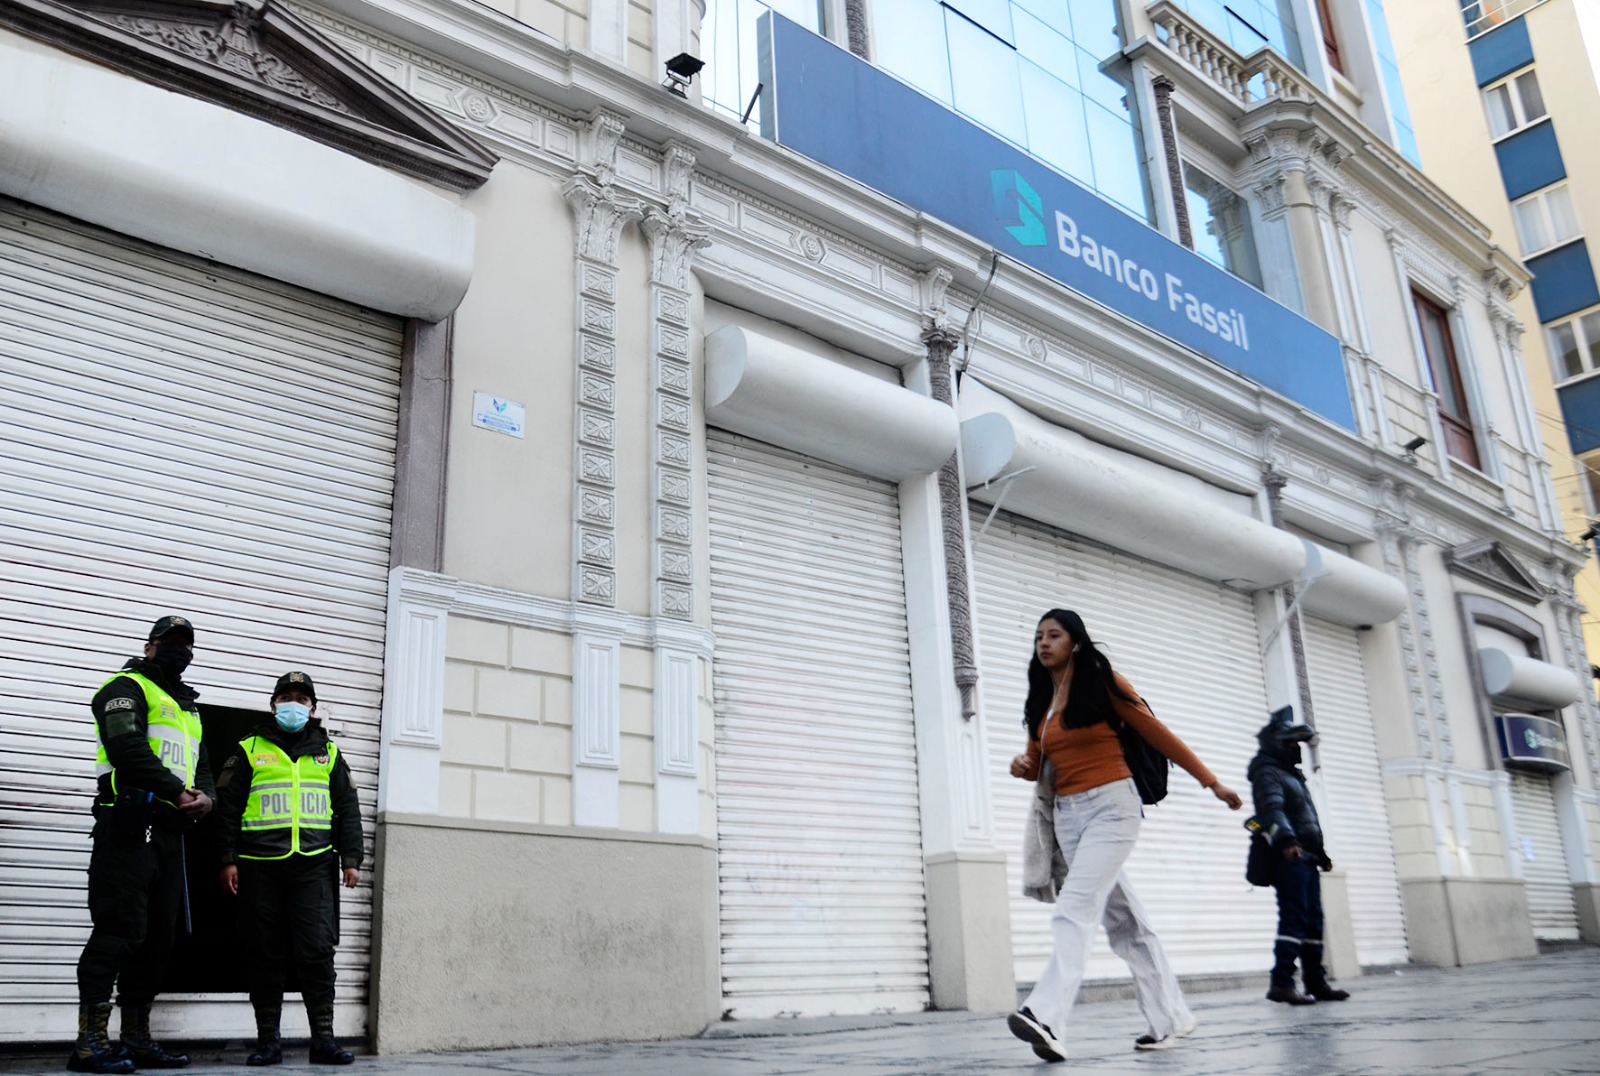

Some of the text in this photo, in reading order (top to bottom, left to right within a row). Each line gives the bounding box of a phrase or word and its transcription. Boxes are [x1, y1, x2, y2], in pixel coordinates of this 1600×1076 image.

[1054, 210, 1249, 351] Banco Fassil
[261, 792, 328, 816] POLICIA
